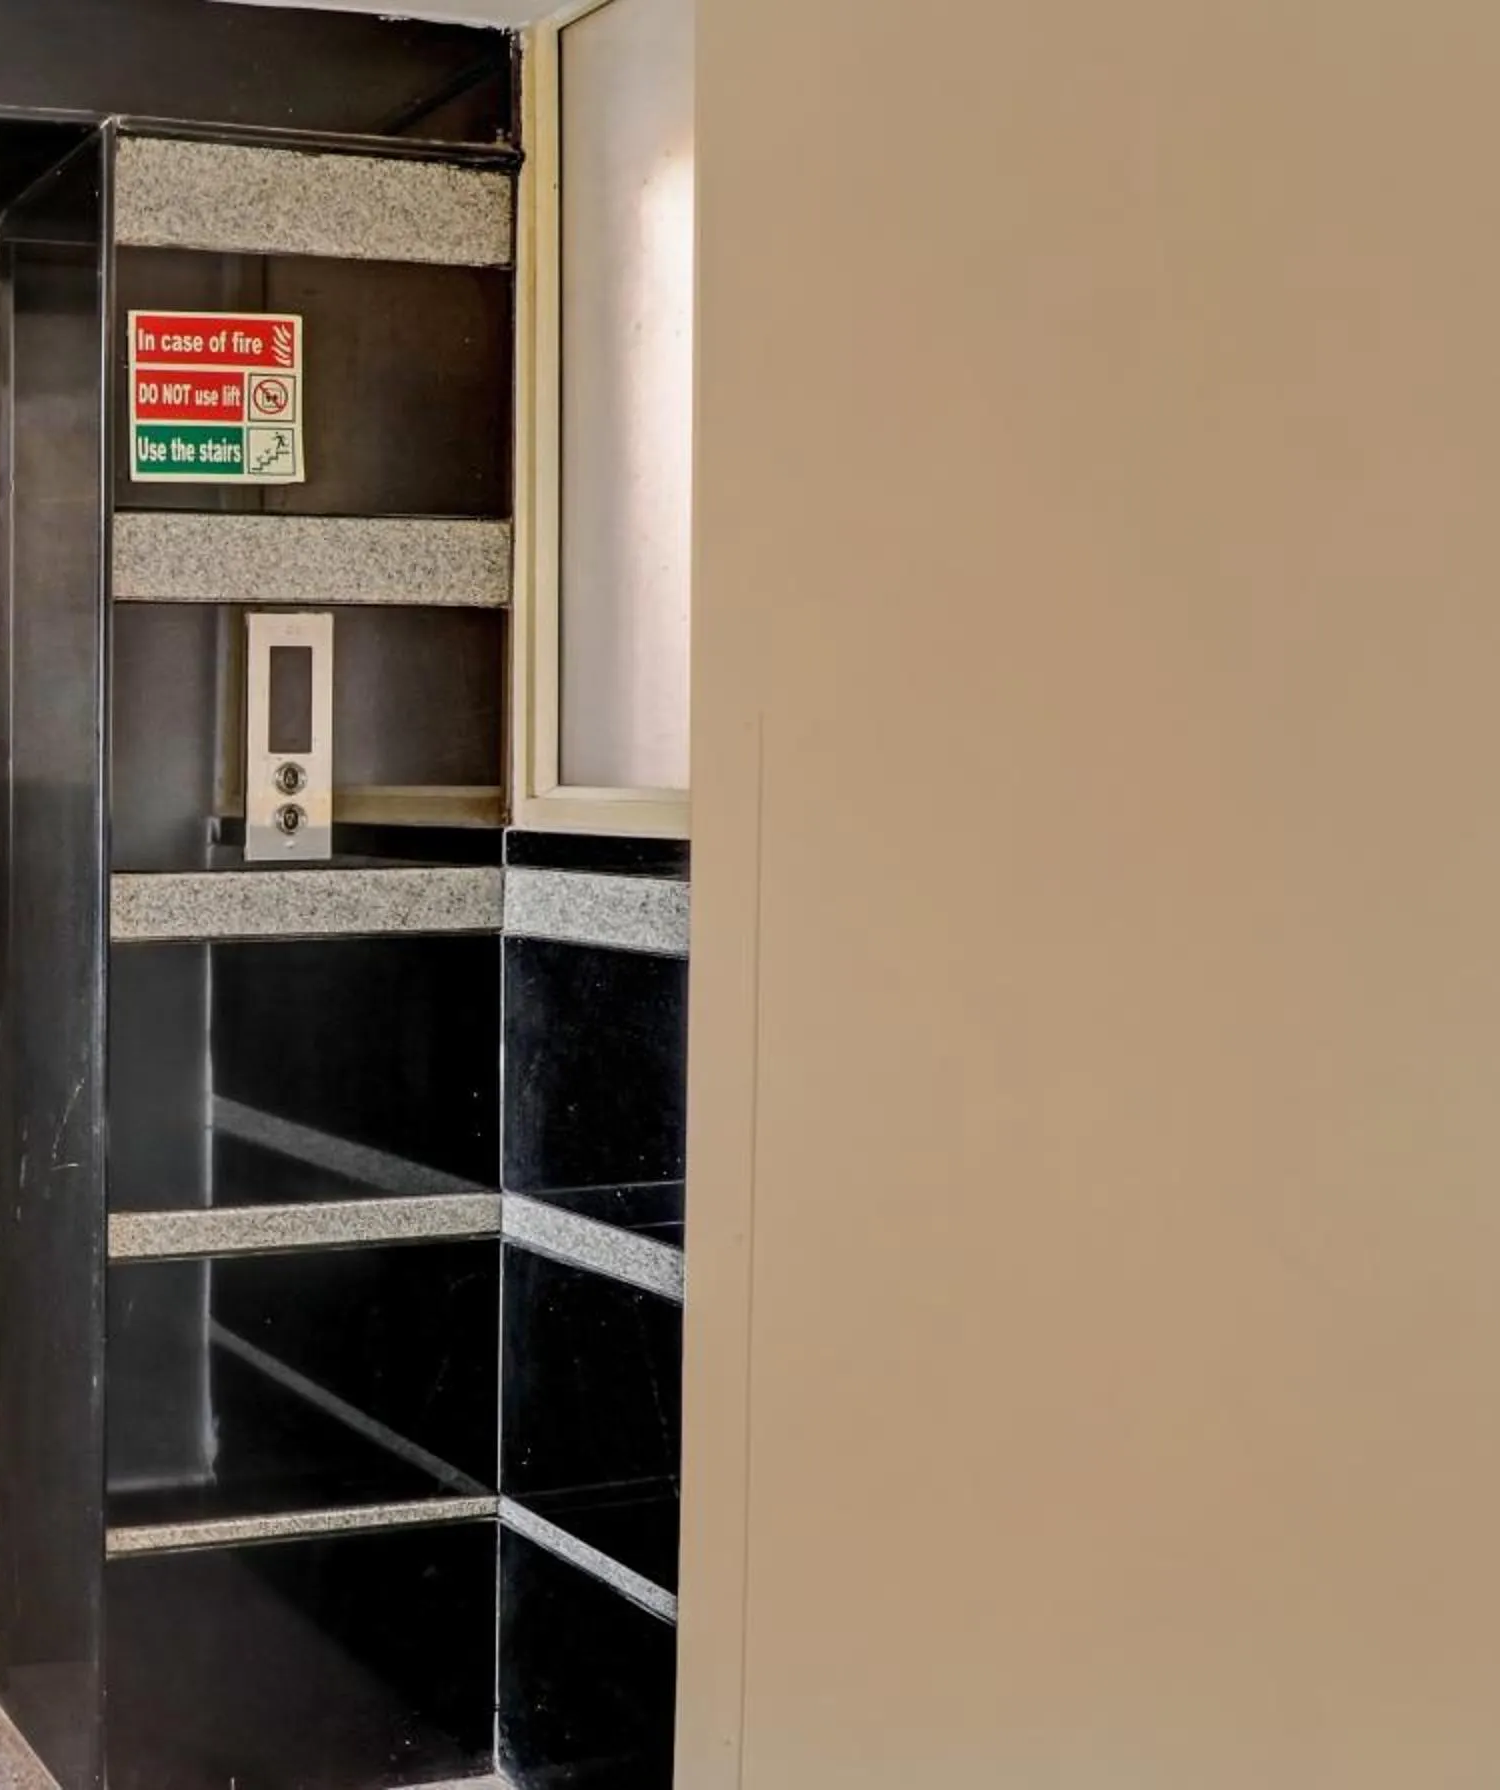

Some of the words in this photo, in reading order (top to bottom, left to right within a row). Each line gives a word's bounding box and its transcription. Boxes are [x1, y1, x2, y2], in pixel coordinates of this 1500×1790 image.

[138, 328, 155, 350] In
[161, 333, 203, 353] case
[209, 329, 228, 353] of
[232, 331, 263, 355] fire
[139, 382, 158, 404] DO
[163, 383, 192, 405] NOT
[195, 387, 219, 406] use
[223, 385, 241, 407] lift
[138, 436, 166, 462] Use
[171, 437, 197, 462] the
[200, 438, 241, 463] stairs
